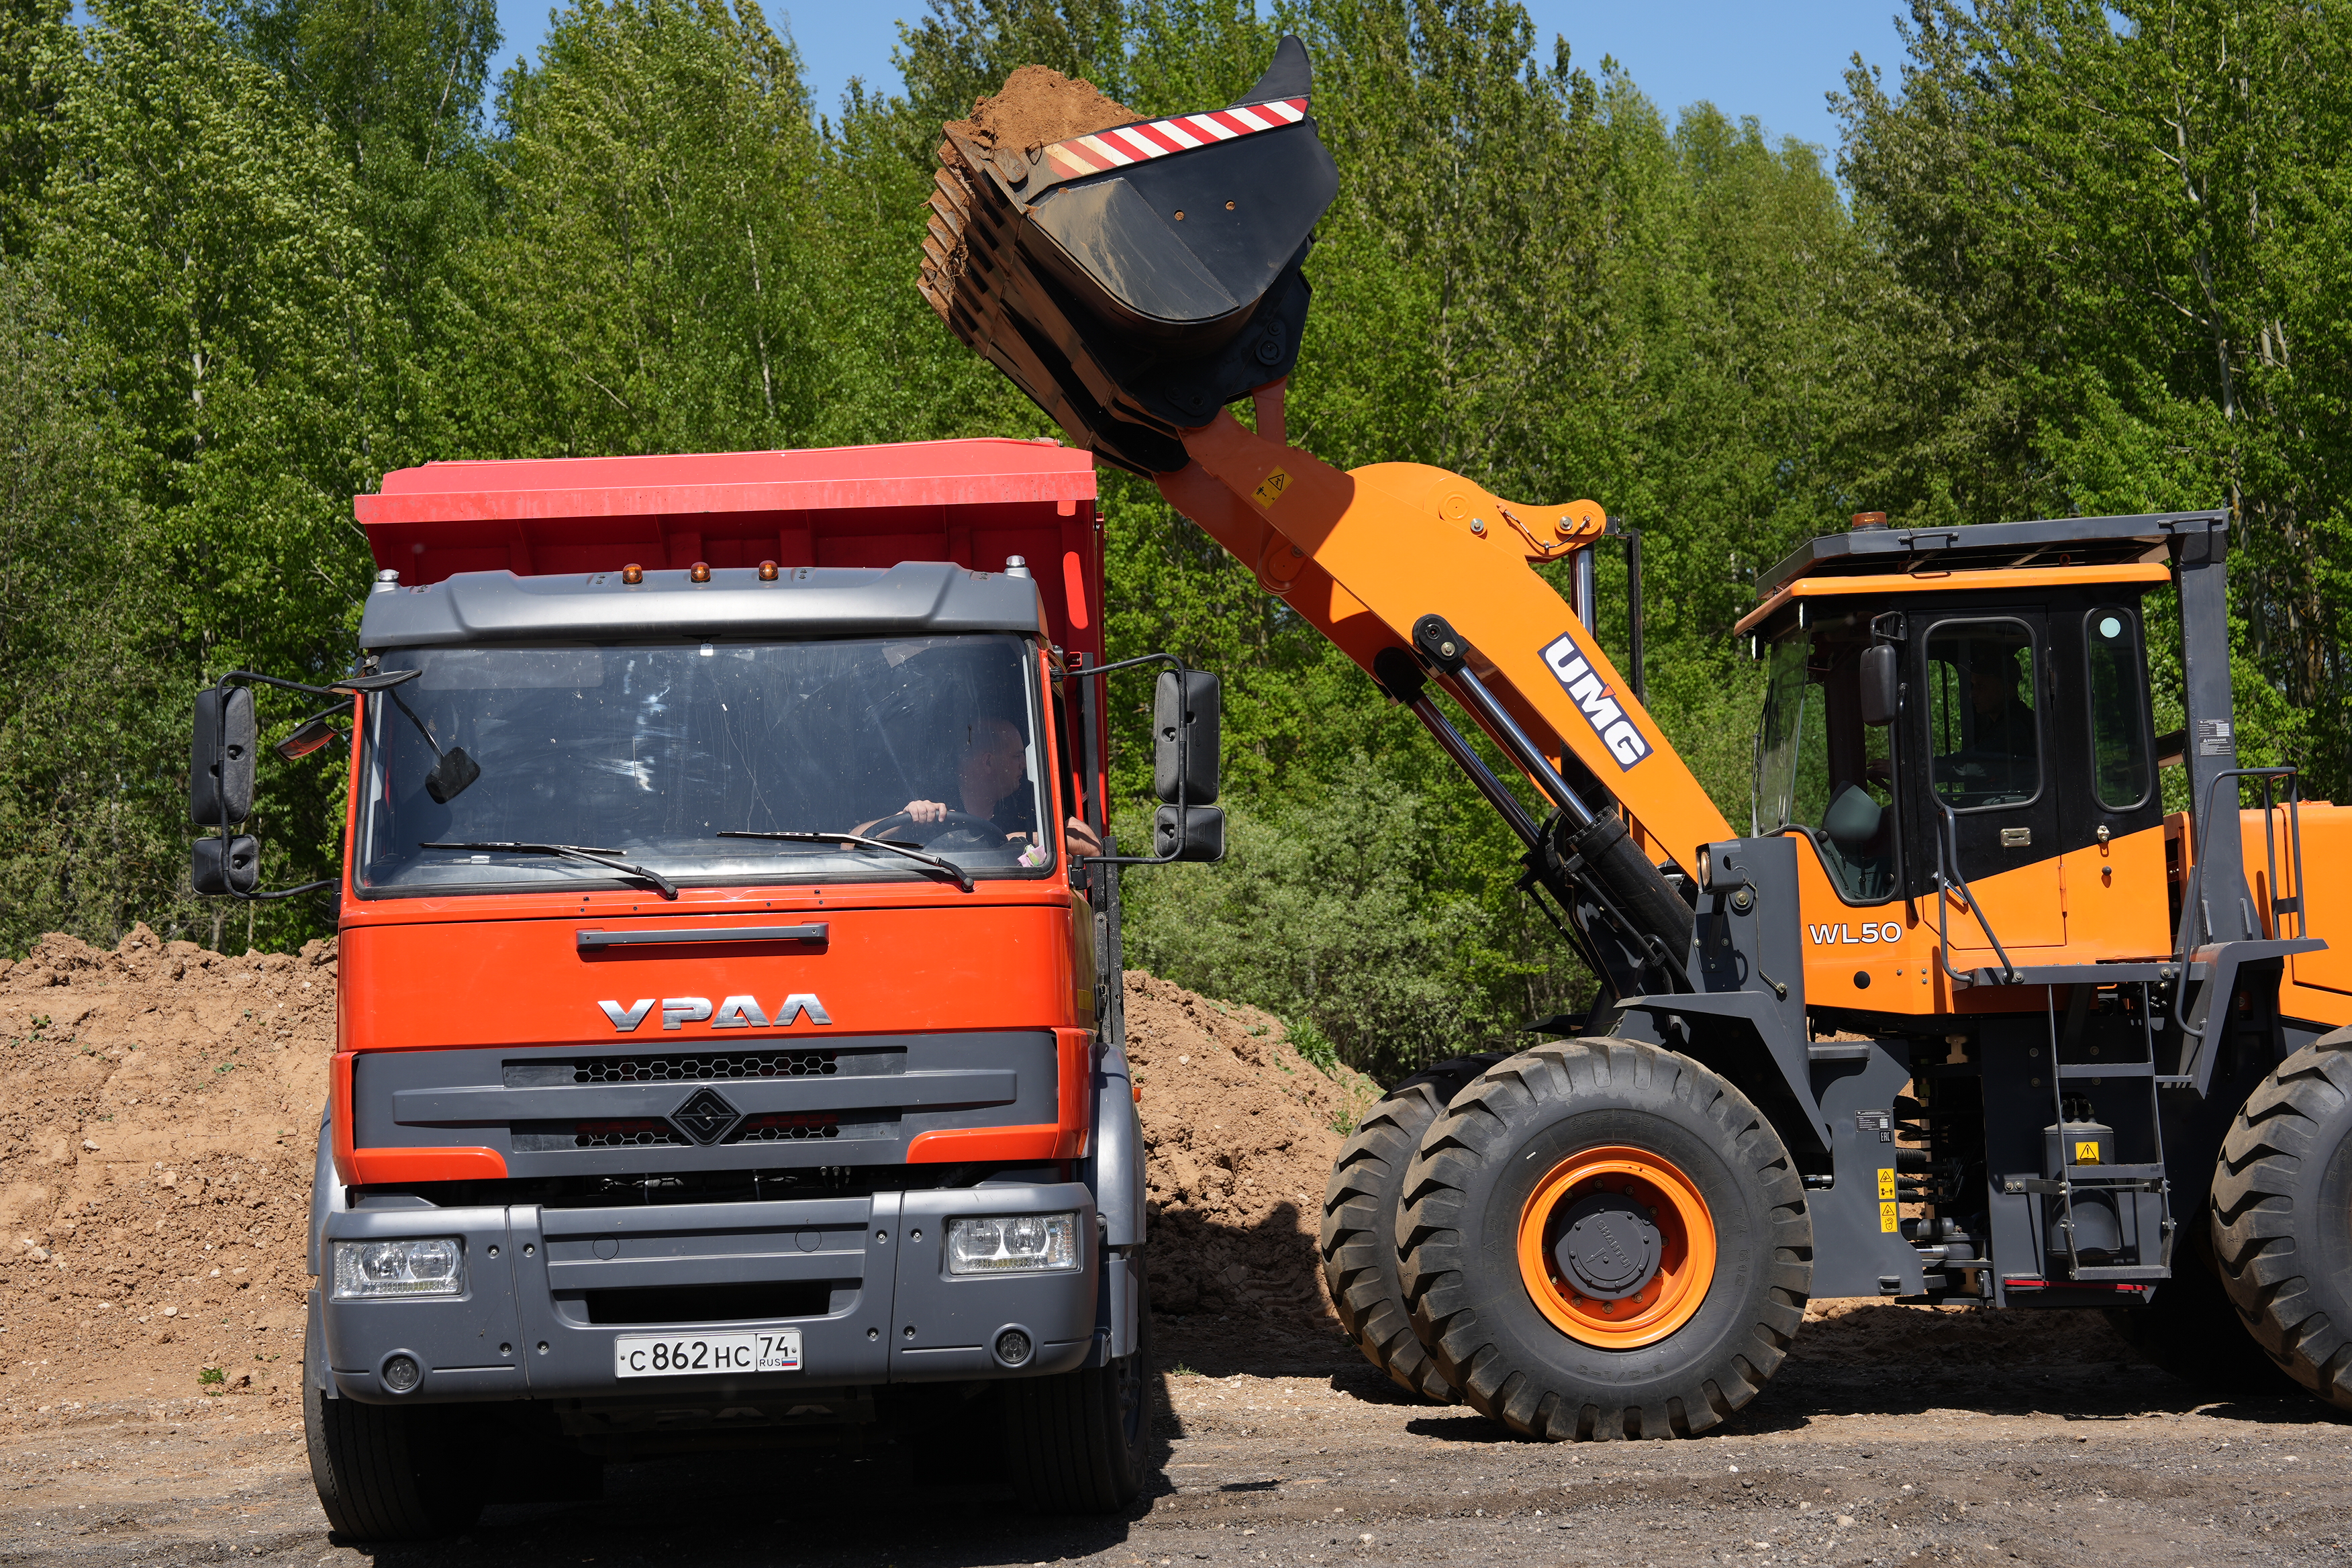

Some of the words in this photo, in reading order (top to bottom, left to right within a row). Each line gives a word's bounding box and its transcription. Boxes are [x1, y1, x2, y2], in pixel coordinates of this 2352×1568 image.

[1545, 634, 1646, 765] UMG
[1808, 922, 1902, 944] WL50
[597, 993, 832, 1032] УРАЛ
[1569, 1112, 1657, 1131] 23.5-25
[1880, 1132, 1890, 1142] EAC
[1596, 1219, 1632, 1269] SHANTUI
[760, 1336, 789, 1357] 74
[759, 1358, 781, 1367] RUS
